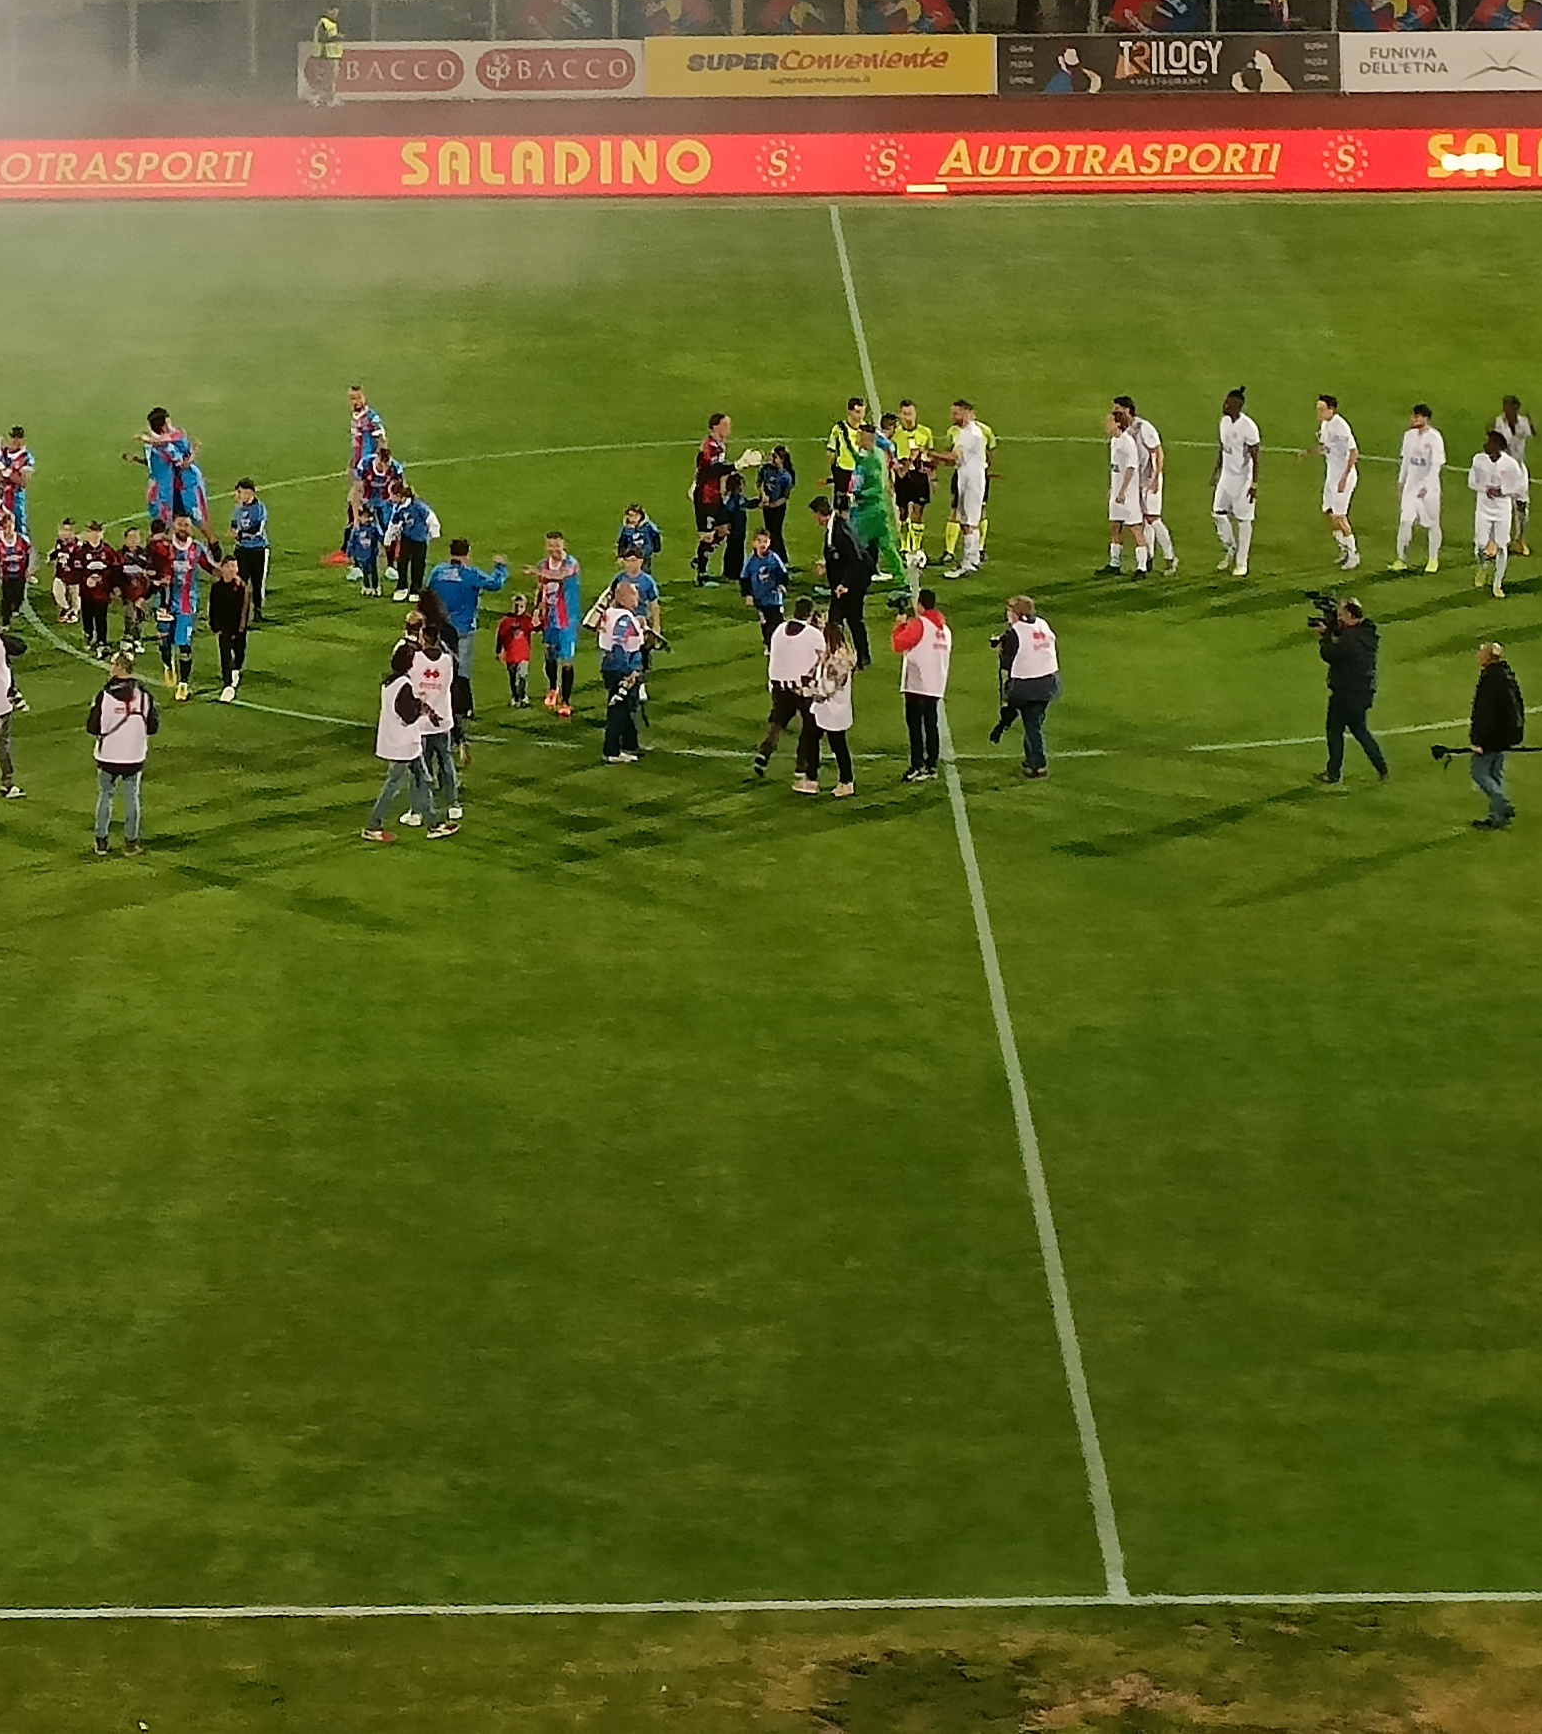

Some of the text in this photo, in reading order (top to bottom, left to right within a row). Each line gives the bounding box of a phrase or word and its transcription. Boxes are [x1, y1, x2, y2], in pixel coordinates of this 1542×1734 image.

[1119, 40, 1223, 76] TRILOGY
[1369, 46, 1438, 60] FUNIVIA
[346, 59, 457, 81] BACCO
[517, 57, 628, 80] BACCO
[1359, 61, 1449, 75] DELL'ETNA
[400, 138, 712, 187] SALADINO
[937, 138, 1282, 177] AUTOTRASPORTI
